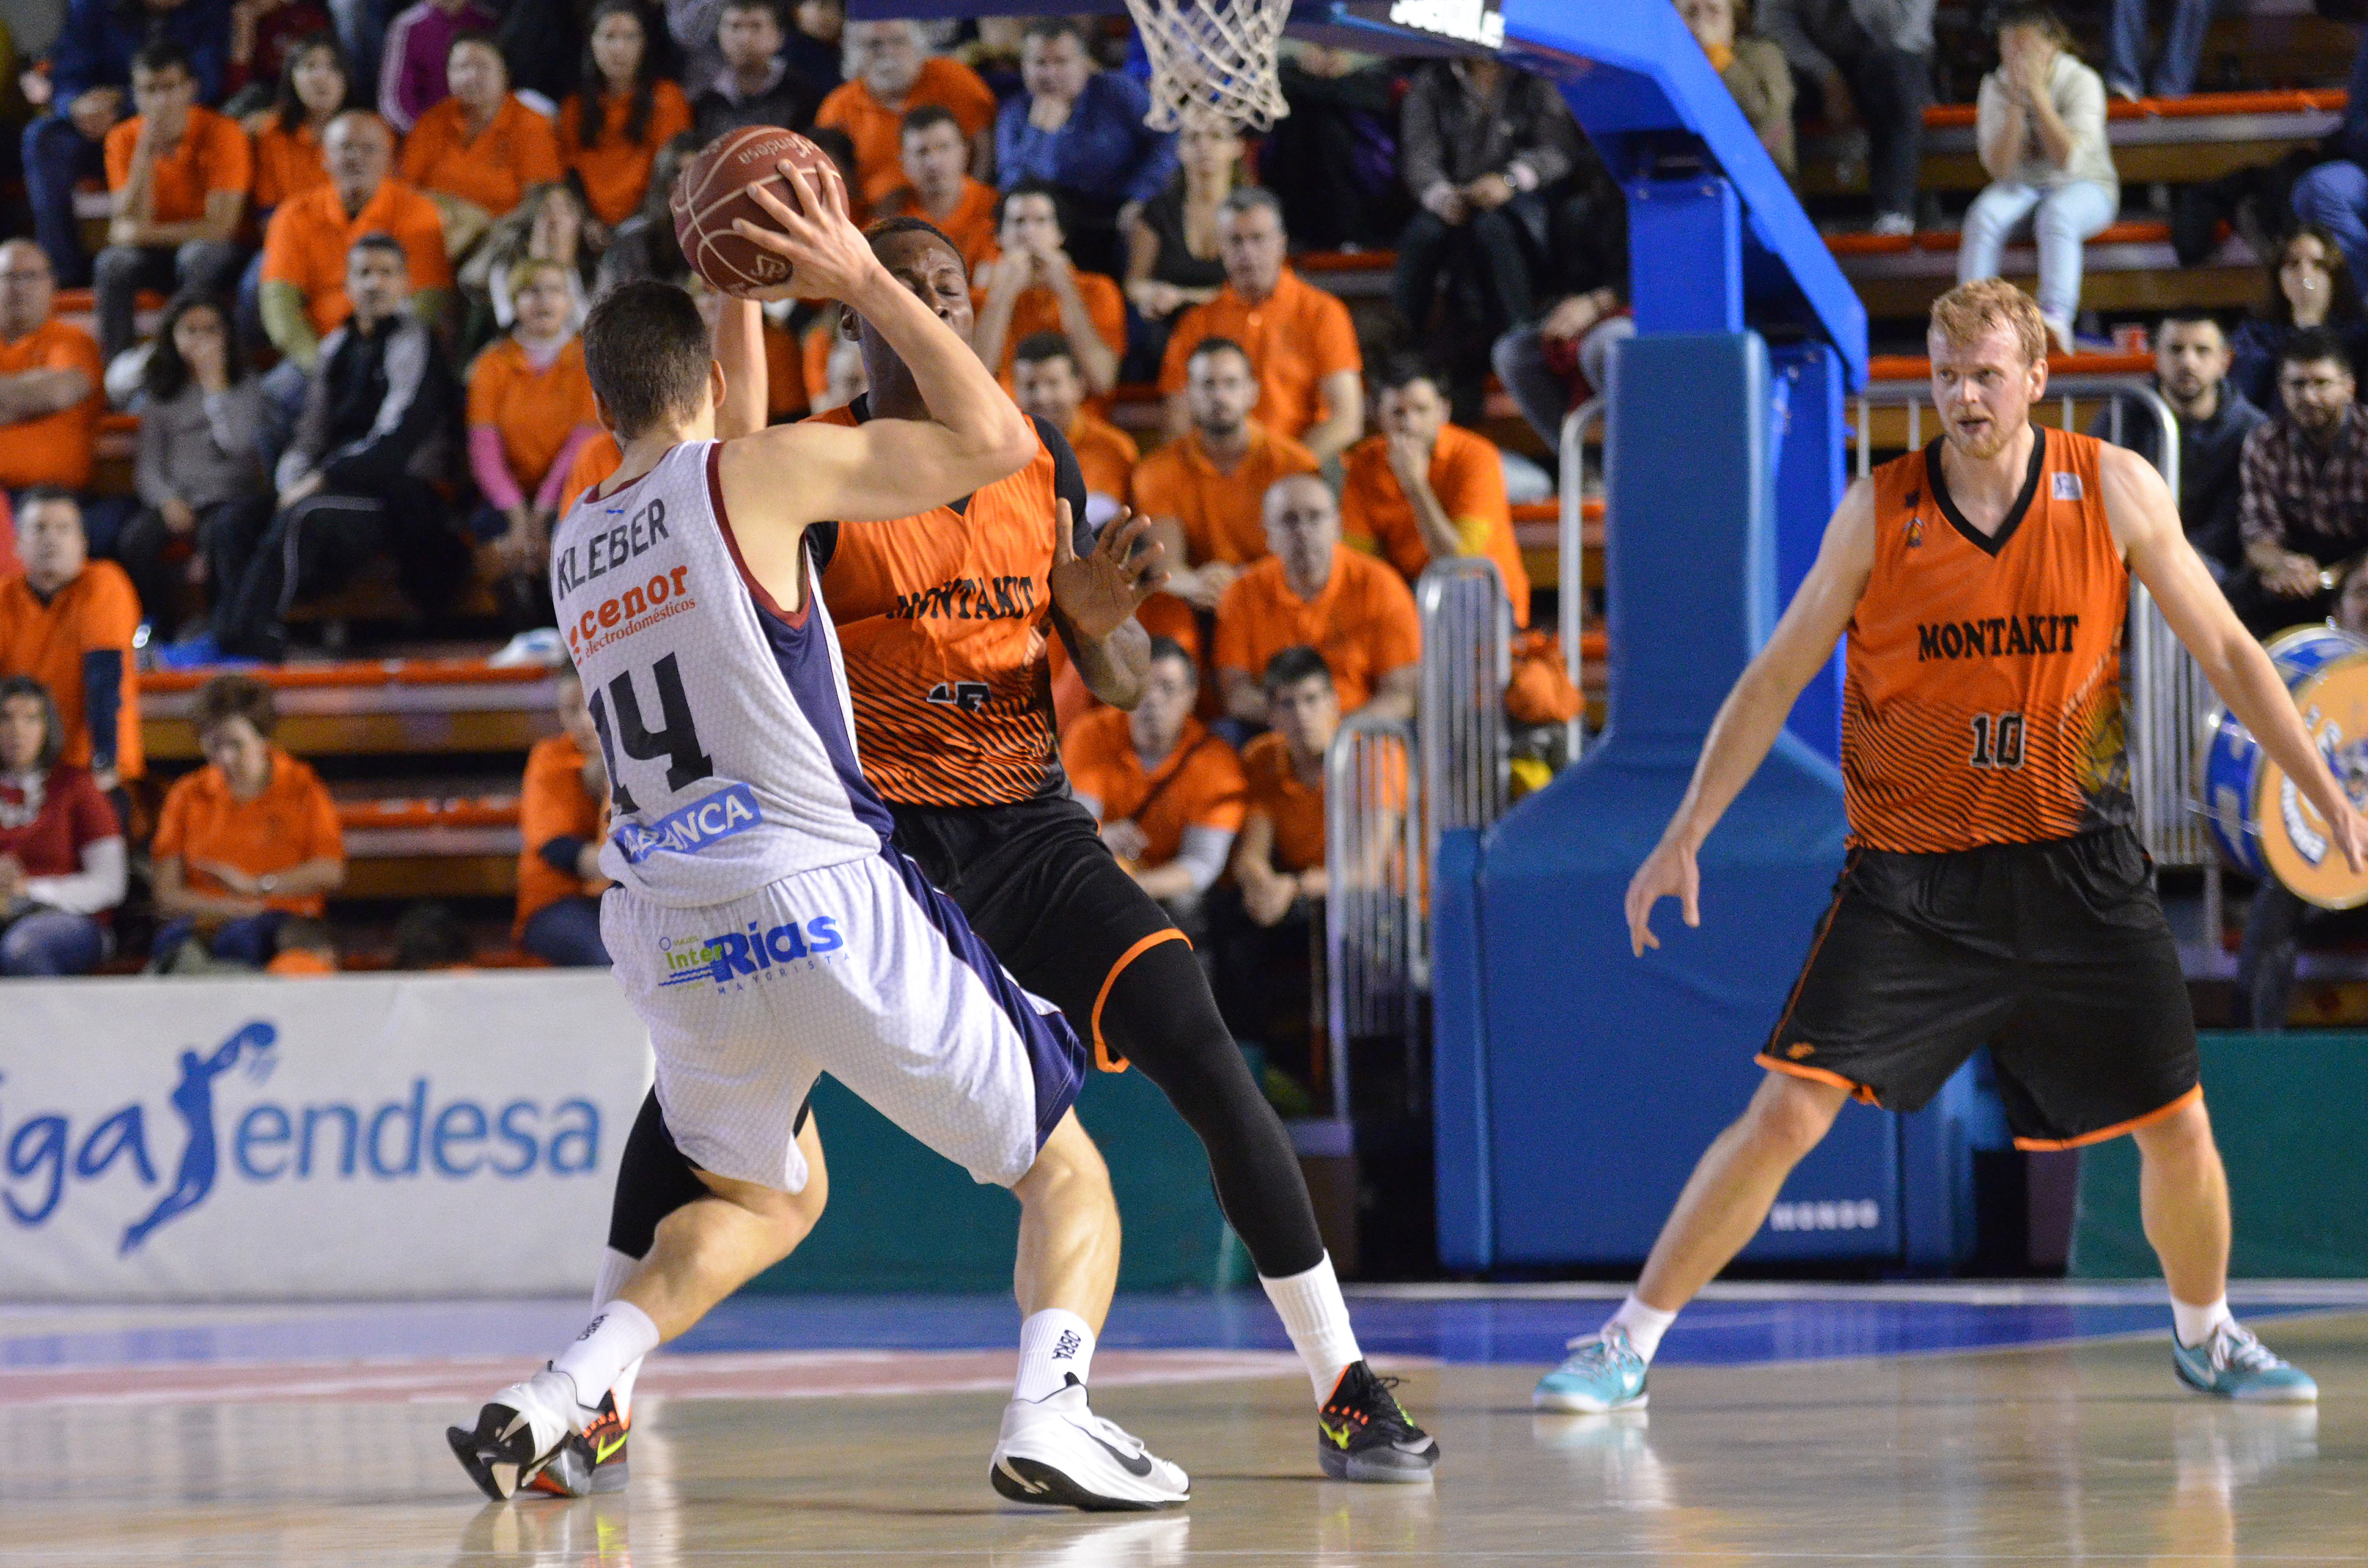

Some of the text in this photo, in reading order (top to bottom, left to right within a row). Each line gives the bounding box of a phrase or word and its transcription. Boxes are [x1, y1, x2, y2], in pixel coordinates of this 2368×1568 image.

[557, 498, 670, 601] KLEBER
[580, 565, 687, 640] cenor
[586, 598, 696, 658] electrodomésticos
[1918, 614, 2079, 662] MONTAKIT
[588, 651, 714, 816] 14
[1970, 712, 2025, 770] 10
[718, 953, 850, 995] MAYORISTA
[233, 1075, 601, 1179] endesa
[1052, 1329, 1081, 1360] OBRA
